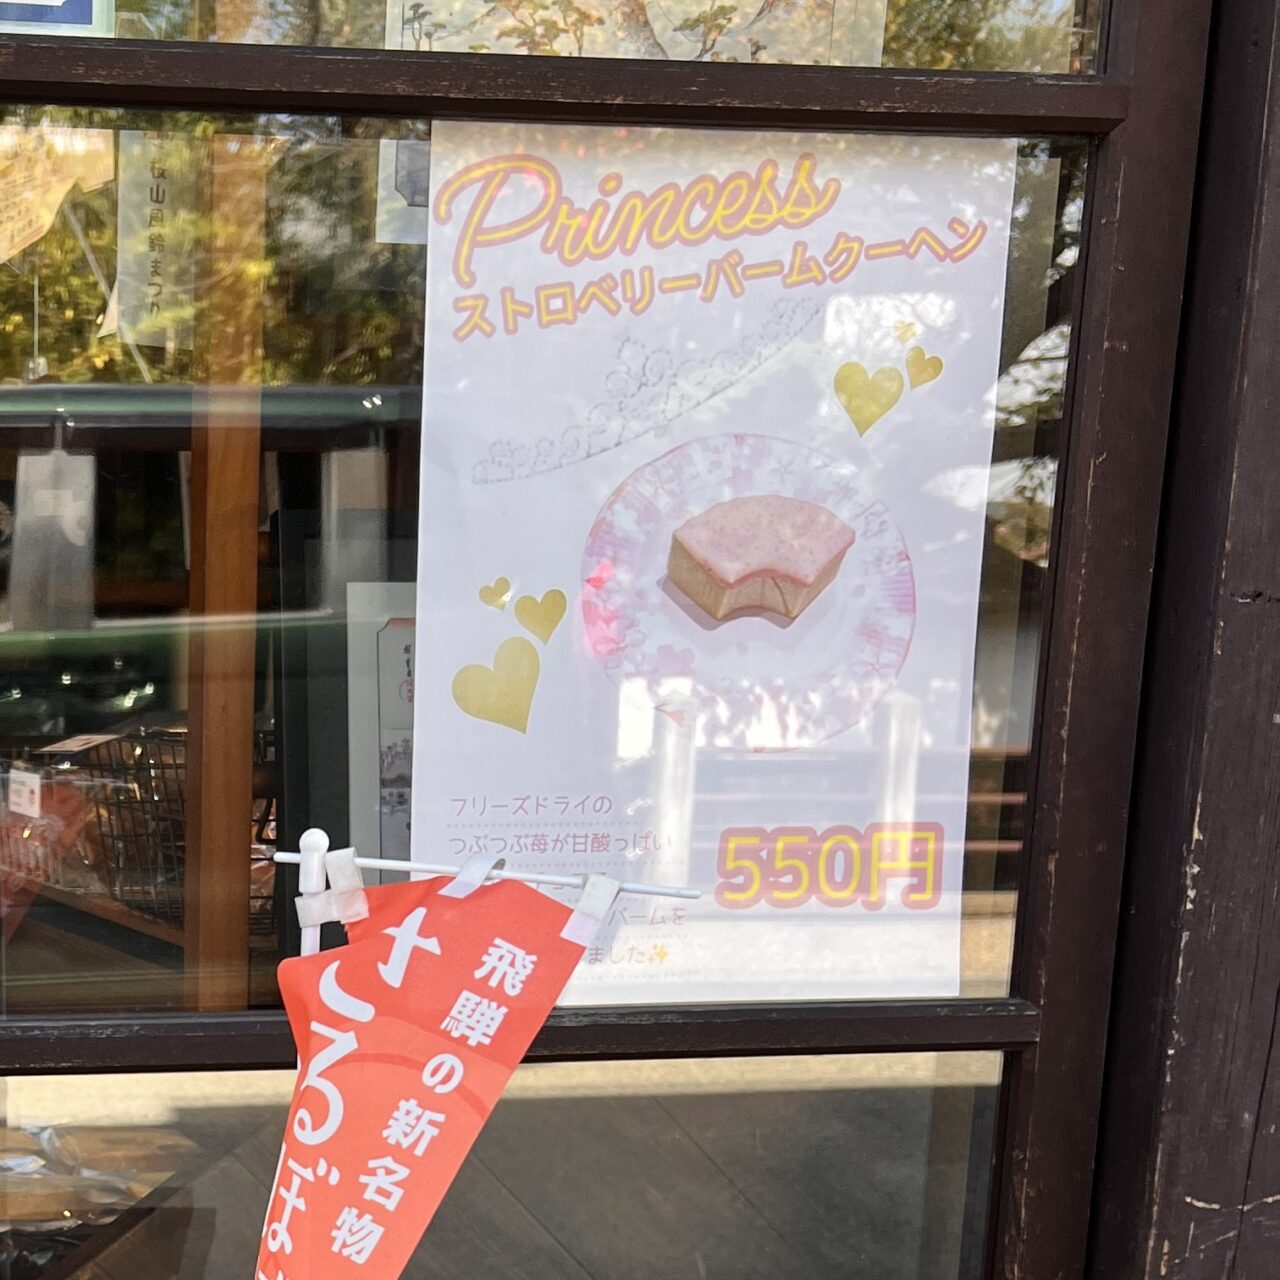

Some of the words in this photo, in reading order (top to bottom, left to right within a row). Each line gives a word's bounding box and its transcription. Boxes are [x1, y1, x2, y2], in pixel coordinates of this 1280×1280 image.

[434, 152, 841, 286] Princess
[453, 218, 987, 342] ストロベリーバームクーヘン
[448, 830, 673, 857] つぶつぶ苺が甘酸っぱい
[449, 794, 613, 818] フリーズドライの
[718, 824, 943, 908] 550円
[331, 937, 538, 1265] 飛騨の新名物
